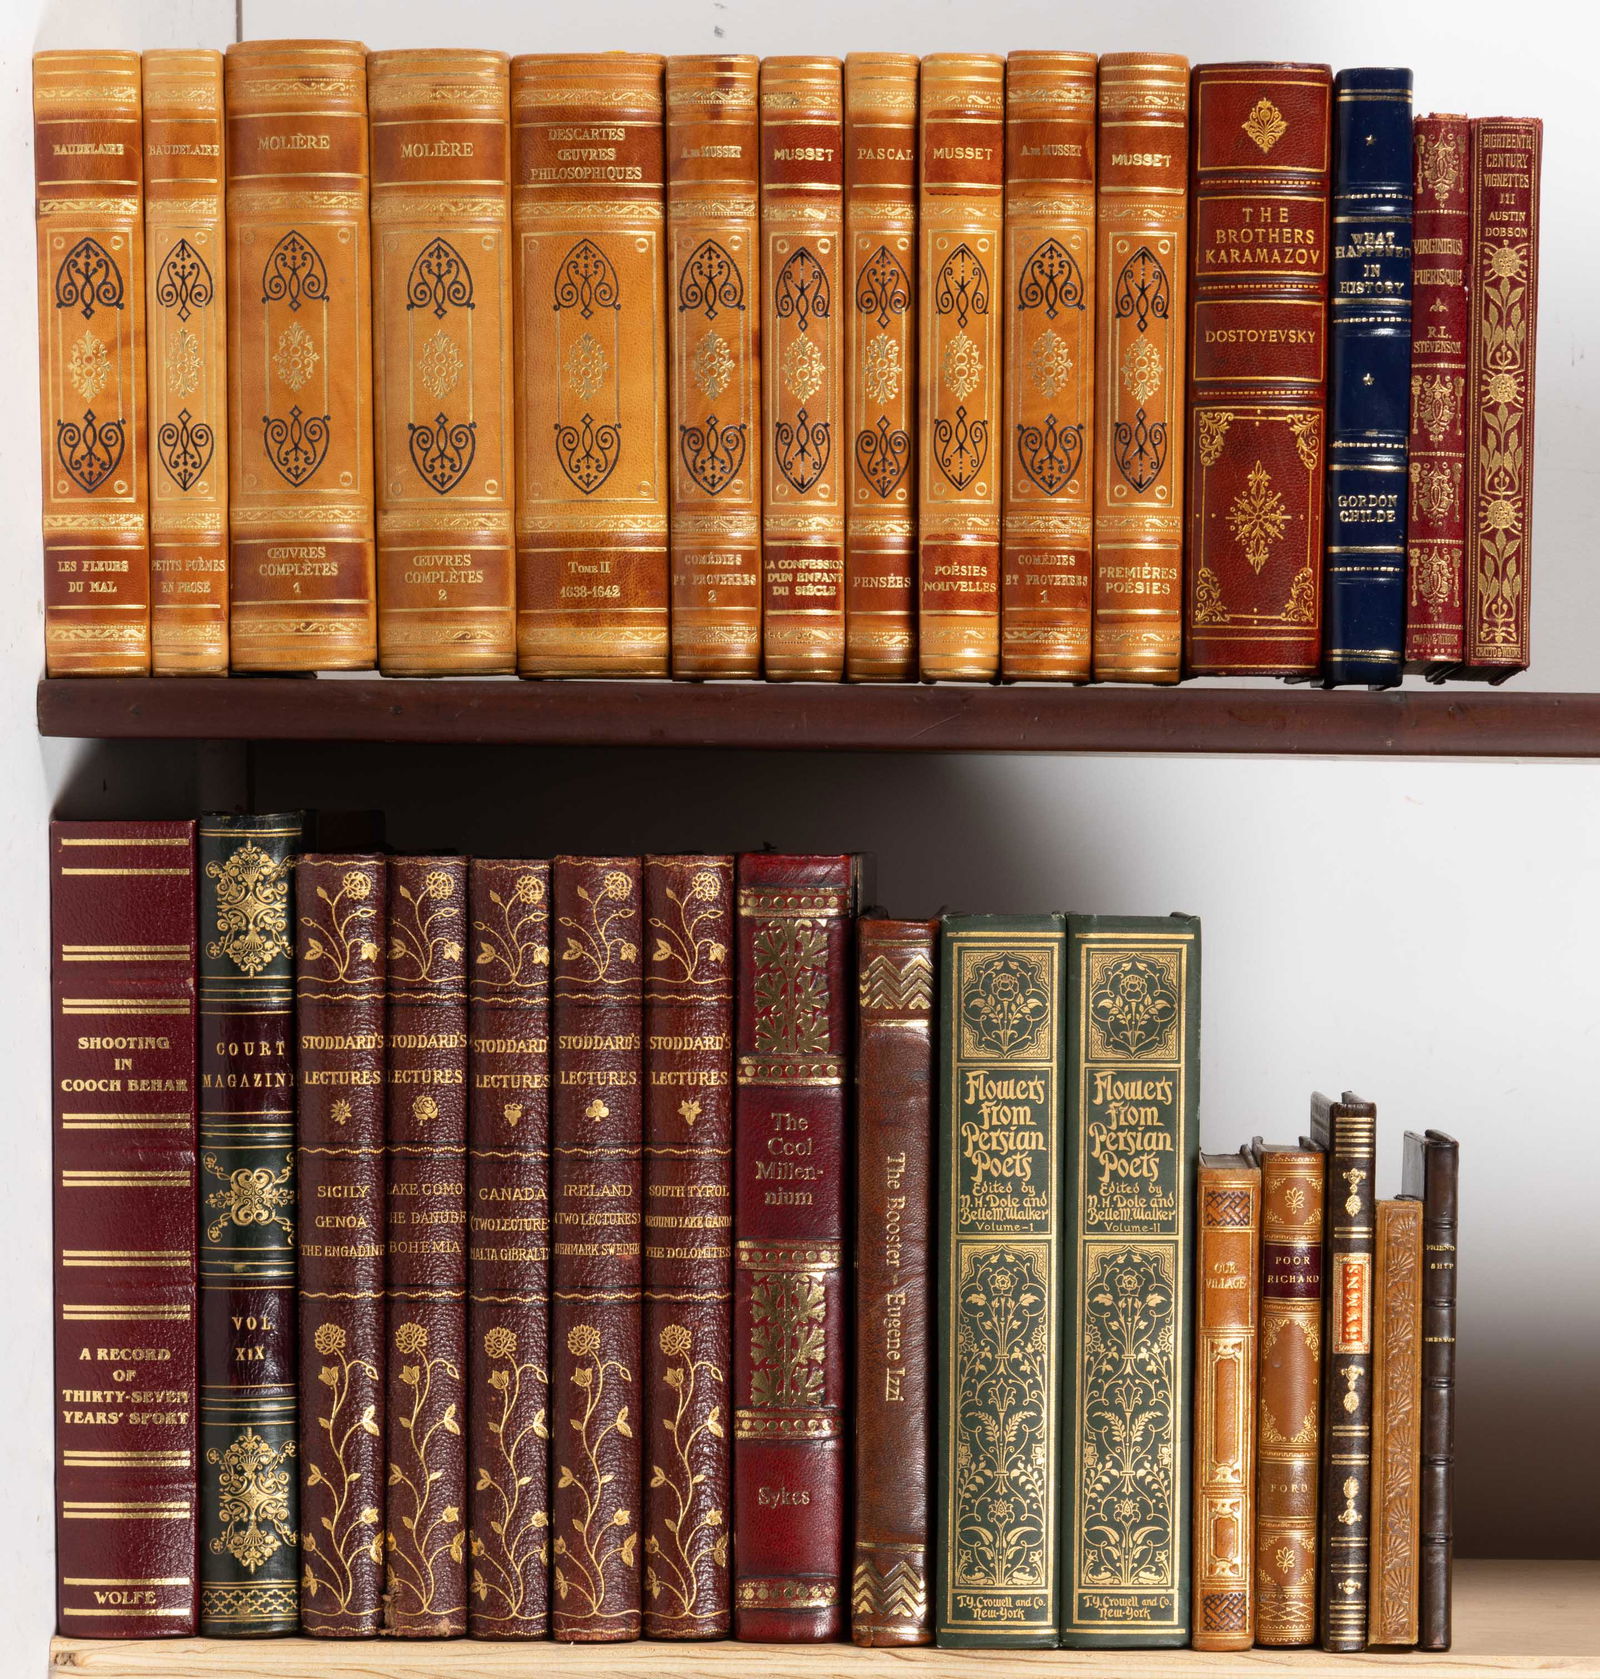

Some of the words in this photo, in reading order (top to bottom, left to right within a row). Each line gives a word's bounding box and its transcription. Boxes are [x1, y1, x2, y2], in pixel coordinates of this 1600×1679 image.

[258, 133, 330, 150] MOLIÈRE
[548, 128, 626, 142] DESCARTES
[1483, 134, 1532, 149] EIGHTEENTH
[150, 144, 220, 156] BAUDELAIRE
[400, 140, 474, 158] MOLIÈRE
[774, 148, 834, 162] MUSSET
[857, 148, 913, 160] PASCAL
[933, 147, 994, 160] MUSSET
[1042, 144, 1082, 157] MUSSET
[1112, 154, 1172, 167] MUSSET
[1486, 154, 1528, 168] CENTURY
[530, 166, 642, 180] PHILOSOPHIQUES
[1484, 174, 1529, 188] VIGNETTES
[1500, 193, 1515, 204] III
[1242, 208, 1288, 222] THE
[1488, 212, 1526, 221] AUSTIN
[1216, 229, 1315, 244] BROTHERS
[1350, 232, 1395, 244] WHAT
[1485, 228, 1528, 237] DOBSON
[1335, 245, 1411, 258] HAPPENED
[1413, 238, 1462, 255] VIRGINIBUS
[1206, 250, 1320, 264] KARAMAZOV
[1364, 264, 1380, 278] IN
[1414, 269, 1462, 286] PUERISQUE
[1339, 282, 1404, 294] HISTORY
[1206, 330, 1316, 344] DOSTOYEVSKY
[1428, 326, 1452, 338] R.L.
[1413, 340, 1461, 354] STEVENSON
[1338, 495, 1398, 508] GORDON
[1340, 510, 1396, 522] CHILDE
[152, 560, 181, 571] PETITS
[185, 556, 225, 571] POÈMES
[684, 552, 742, 565] COMÉDIES
[778, 559, 844, 569] CONFESSION
[1018, 552, 1075, 566] COMÉDIES
[57, 560, 78, 572] LES
[82, 560, 128, 572] FLEURS
[259, 558, 338, 576] COMPLÈTES
[599, 562, 611, 573] II
[934, 562, 987, 577] POÉSIES
[1099, 563, 1178, 579] PREMIÈRES
[404, 567, 484, 584] COMPLÈTES
[692, 574, 756, 586] PROVERBES
[797, 572, 843, 582] ENFANT
[853, 573, 911, 588] PENSÉES
[1005, 575, 1018, 585] ET
[1025, 575, 1087, 586] PROVERBES
[68, 581, 86, 592] DU
[90, 581, 117, 592] MAL
[162, 582, 174, 592] EN
[178, 581, 211, 592] PROSE
[292, 582, 302, 593] 1
[560, 585, 621, 598] 1638-1642
[773, 586, 789, 595] DU
[924, 581, 996, 593] NOUVELLES
[1106, 579, 1170, 594] POÉSIES
[438, 589, 447, 601] 2
[708, 590, 717, 603] 2
[1040, 590, 1049, 603] 1
[78, 1037, 170, 1049] SHOOTING
[216, 1041, 285, 1056] COURT
[302, 1033, 384, 1050] STODDARD'S
[559, 1033, 640, 1050] STODDARD'S
[650, 1033, 731, 1050] STODDARD'S
[114, 1058, 132, 1070] IN
[304, 1070, 381, 1085] LECTURES
[476, 1074, 550, 1088] LECTURES
[560, 1071, 637, 1085] LECTURES
[652, 1071, 728, 1086] LECTURES
[61, 1079, 121, 1092] COOCH
[128, 1079, 188, 1091] BEHAR
[964, 1070, 1045, 1104] Flowers
[1092, 1070, 1173, 1105] Flowers
[771, 1113, 809, 1131] The
[978, 1101, 1036, 1130] From
[1105, 1101, 1165, 1130] From
[767, 1137, 812, 1156] Cool
[961, 1121, 1047, 1158] Persian
[1088, 1122, 1174, 1158] Persian
[755, 1161, 824, 1180] Millen-
[887, 1152, 905, 1189] The
[970, 1151, 1033, 1183] Poets
[1098, 1151, 1160, 1183] Poets
[317, 1185, 370, 1198] SICILY
[422, 1183, 463, 1196] COMO
[479, 1188, 547, 1200] CANADA
[564, 1184, 632, 1197] IRELAND
[649, 1185, 685, 1197] SOUTH
[688, 1185, 729, 1198] TYROL
[765, 1186, 813, 1206] nium
[972, 1182, 1012, 1196] Edited
[1021, 1182, 1035, 1196] by
[1100, 1182, 1140, 1196] Edited
[1148, 1182, 1162, 1197] by
[986, 1194, 1020, 1207] Dole
[1023, 1191, 1047, 1207] and
[1113, 1194, 1147, 1208] Dole
[1150, 1192, 1175, 1208] and
[315, 1216, 368, 1228] GENOA
[470, 1216, 495, 1232] (TWO
[554, 1213, 578, 1224] (TWO
[581, 1213, 640, 1225] LECTURES)
[678, 1216, 703, 1228] LAKE
[886, 1196, 905, 1267] Booster
[301, 1244, 322, 1257] THE
[389, 1241, 461, 1253] BOHEMIA
[601, 1243, 640, 1256] SWEDEN
[666, 1246, 731, 1258] DOLOMITES
[1214, 1261, 1237, 1274] OUR
[1275, 1256, 1310, 1265] POOR
[1206, 1276, 1247, 1289] VILLAGE
[1267, 1275, 1319, 1283] RICHARD
[1346, 1265, 1360, 1340] HYMNS
[884, 1294, 905, 1360] Eugene
[79, 1348, 91, 1360] A
[97, 1348, 171, 1361] RECORD
[236, 1343, 265, 1360] XIX
[112, 1370, 136, 1382] OF
[886, 1367, 905, 1402] Izzi
[62, 1390, 189, 1403] THIRTY-SEVEN
[63, 1412, 123, 1424] YEARS'
[129, 1412, 189, 1425] SPORT
[1271, 1483, 1308, 1493] FORD
[758, 1486, 810, 1509] Sykes
[94, 1591, 156, 1605] WOLFE
[1016, 1596, 1031, 1607] and
[1033, 1596, 1046, 1610] Co.
[1141, 1596, 1158, 1607] and
[1159, 1596, 1172, 1610] Co.
[973, 1607, 1025, 1620] New-York
[1100, 1607, 1151, 1620] New-York
